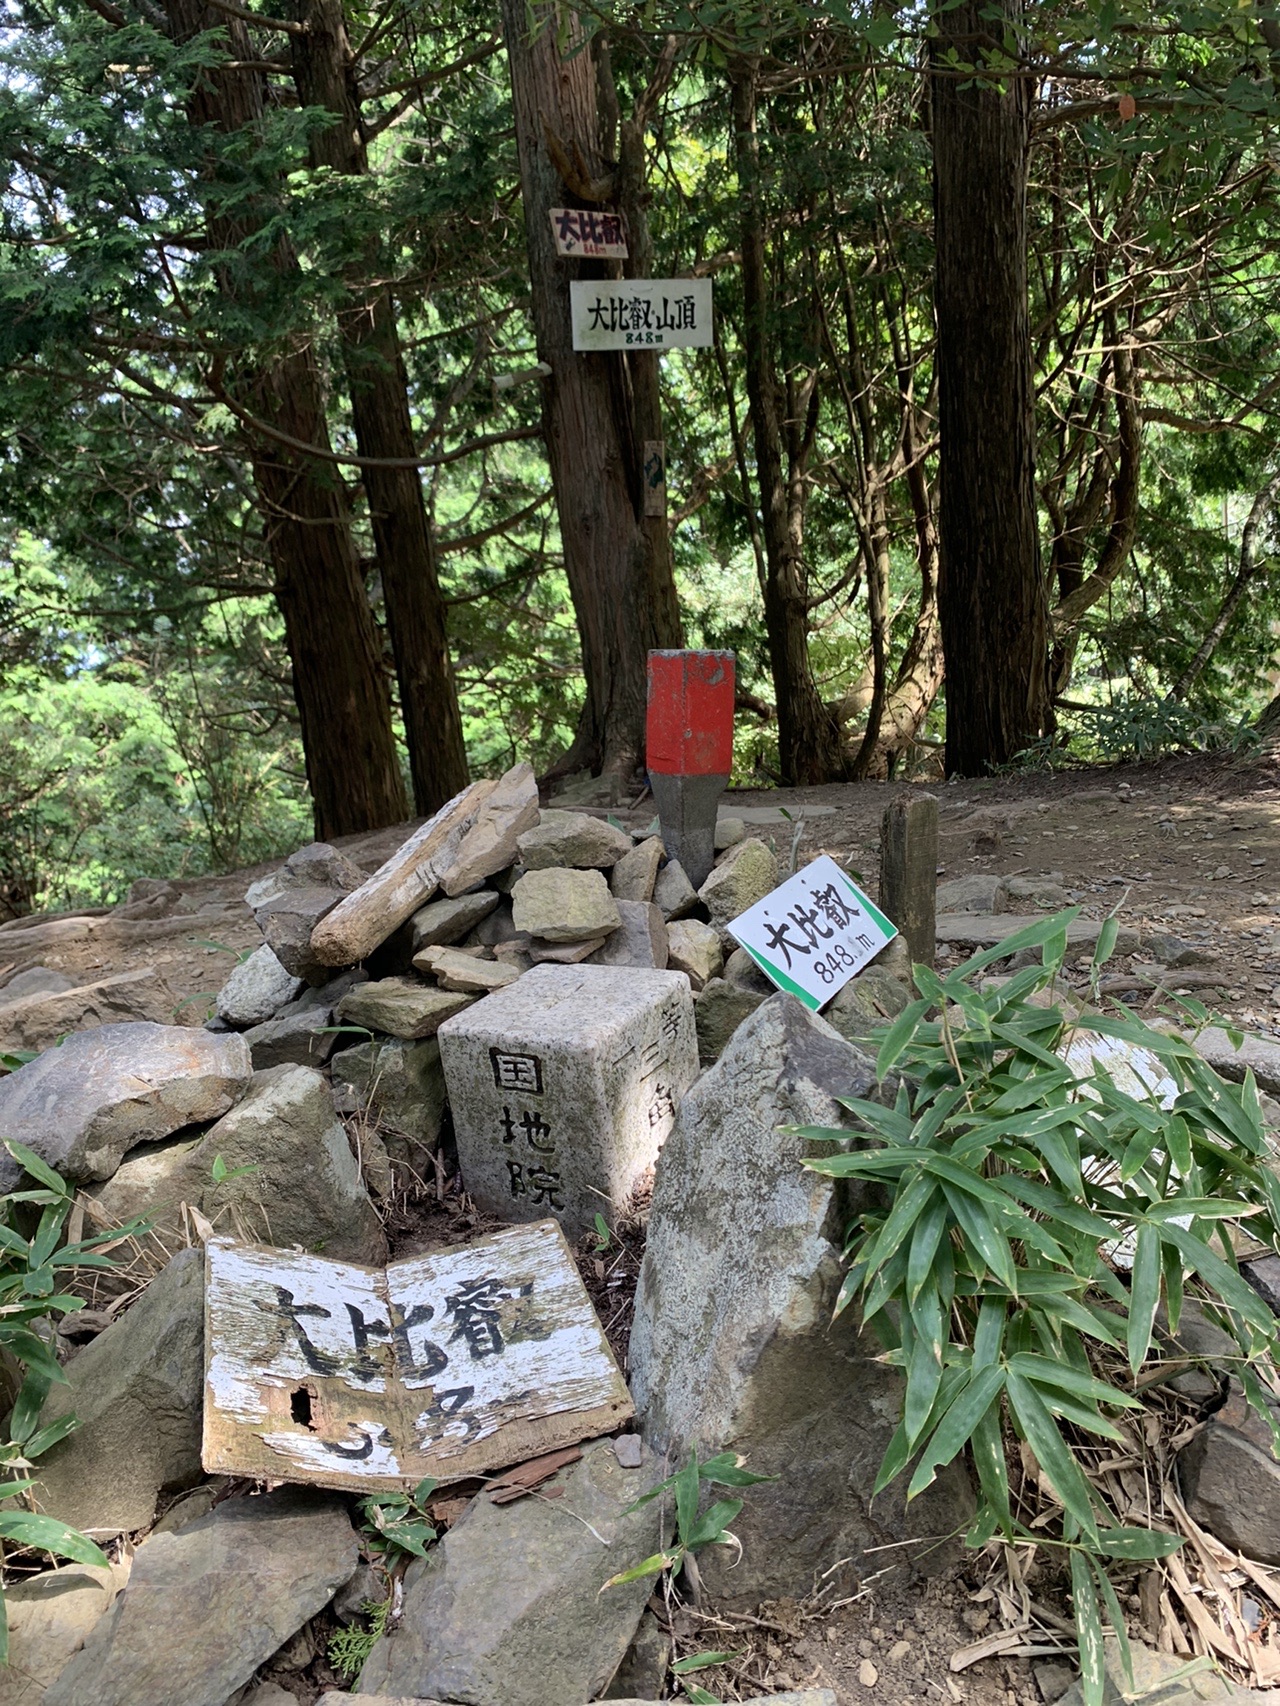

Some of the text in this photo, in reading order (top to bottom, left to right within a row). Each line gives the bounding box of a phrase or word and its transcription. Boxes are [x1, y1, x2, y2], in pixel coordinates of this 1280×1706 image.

[555, 210, 625, 245] 大比叡
[587, 295, 697, 332] 大比叡山頂
[625, 331, 663, 344] 848m
[762, 883, 861, 971] 大比叡
[489, 1046, 566, 1213] 国地院
